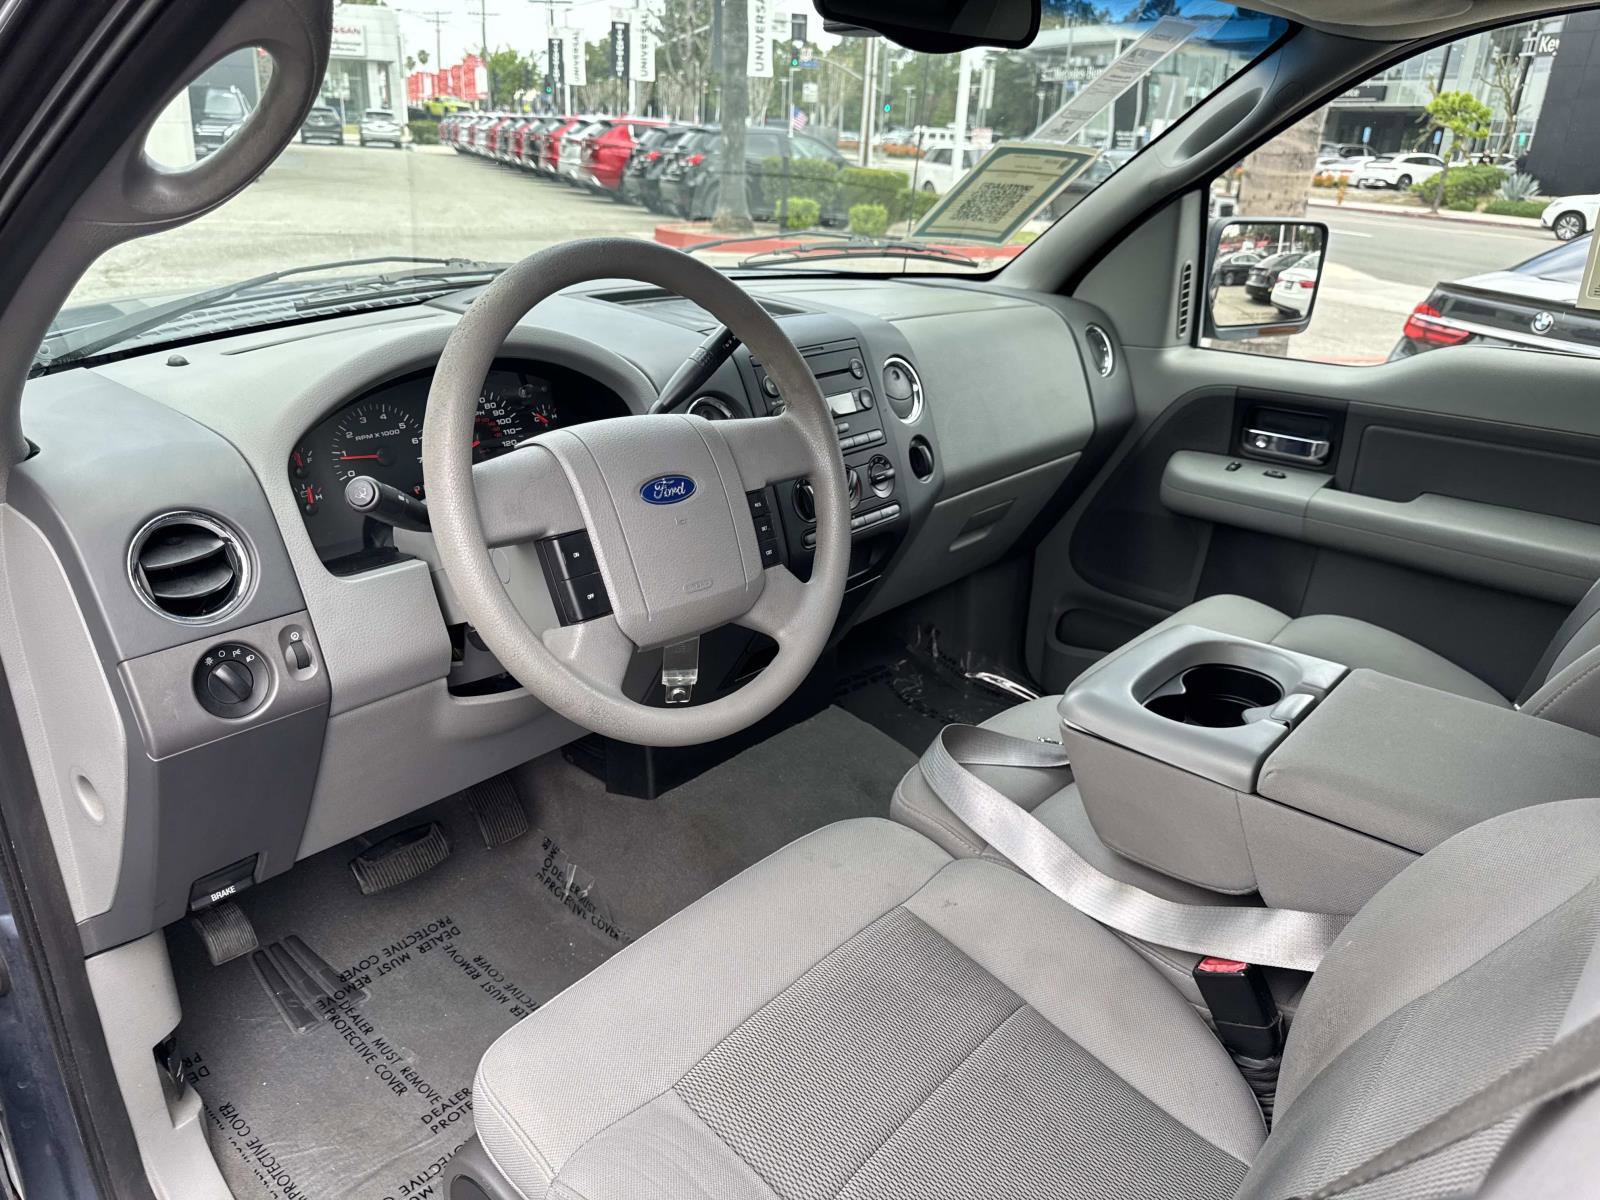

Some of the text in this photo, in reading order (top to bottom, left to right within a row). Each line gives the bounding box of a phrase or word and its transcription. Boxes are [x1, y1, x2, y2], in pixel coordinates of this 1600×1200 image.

[640, 13, 648, 77] UNIVERSAL
[755, 0, 766, 72] UNIVERS
[484, 402, 497, 410] 80
[492, 409, 505, 417] 90
[496, 417, 512, 425] 100
[381, 429, 400, 437] 1000
[502, 439, 518, 447] 120
[654, 478, 686, 499] Ford
[211, 885, 236, 902] BRAKE
[337, 915, 453, 983] PROTECTIVE COVER
[443, 943, 481, 980] REMOVE
[316, 926, 461, 1010] DEALER MUST REMOVE
[473, 955, 504, 982] COVER
[480, 981, 510, 1004] MUST
[324, 1007, 408, 1096] PROTECTIVE COVER
[339, 1000, 442, 1105] DEALER MUST REMOVE
[218, 1101, 251, 1137] COVER
[421, 1087, 473, 1124] DEALER
[430, 1101, 473, 1134] PROTE
[245, 1136, 297, 1200] PROTECTIVE
